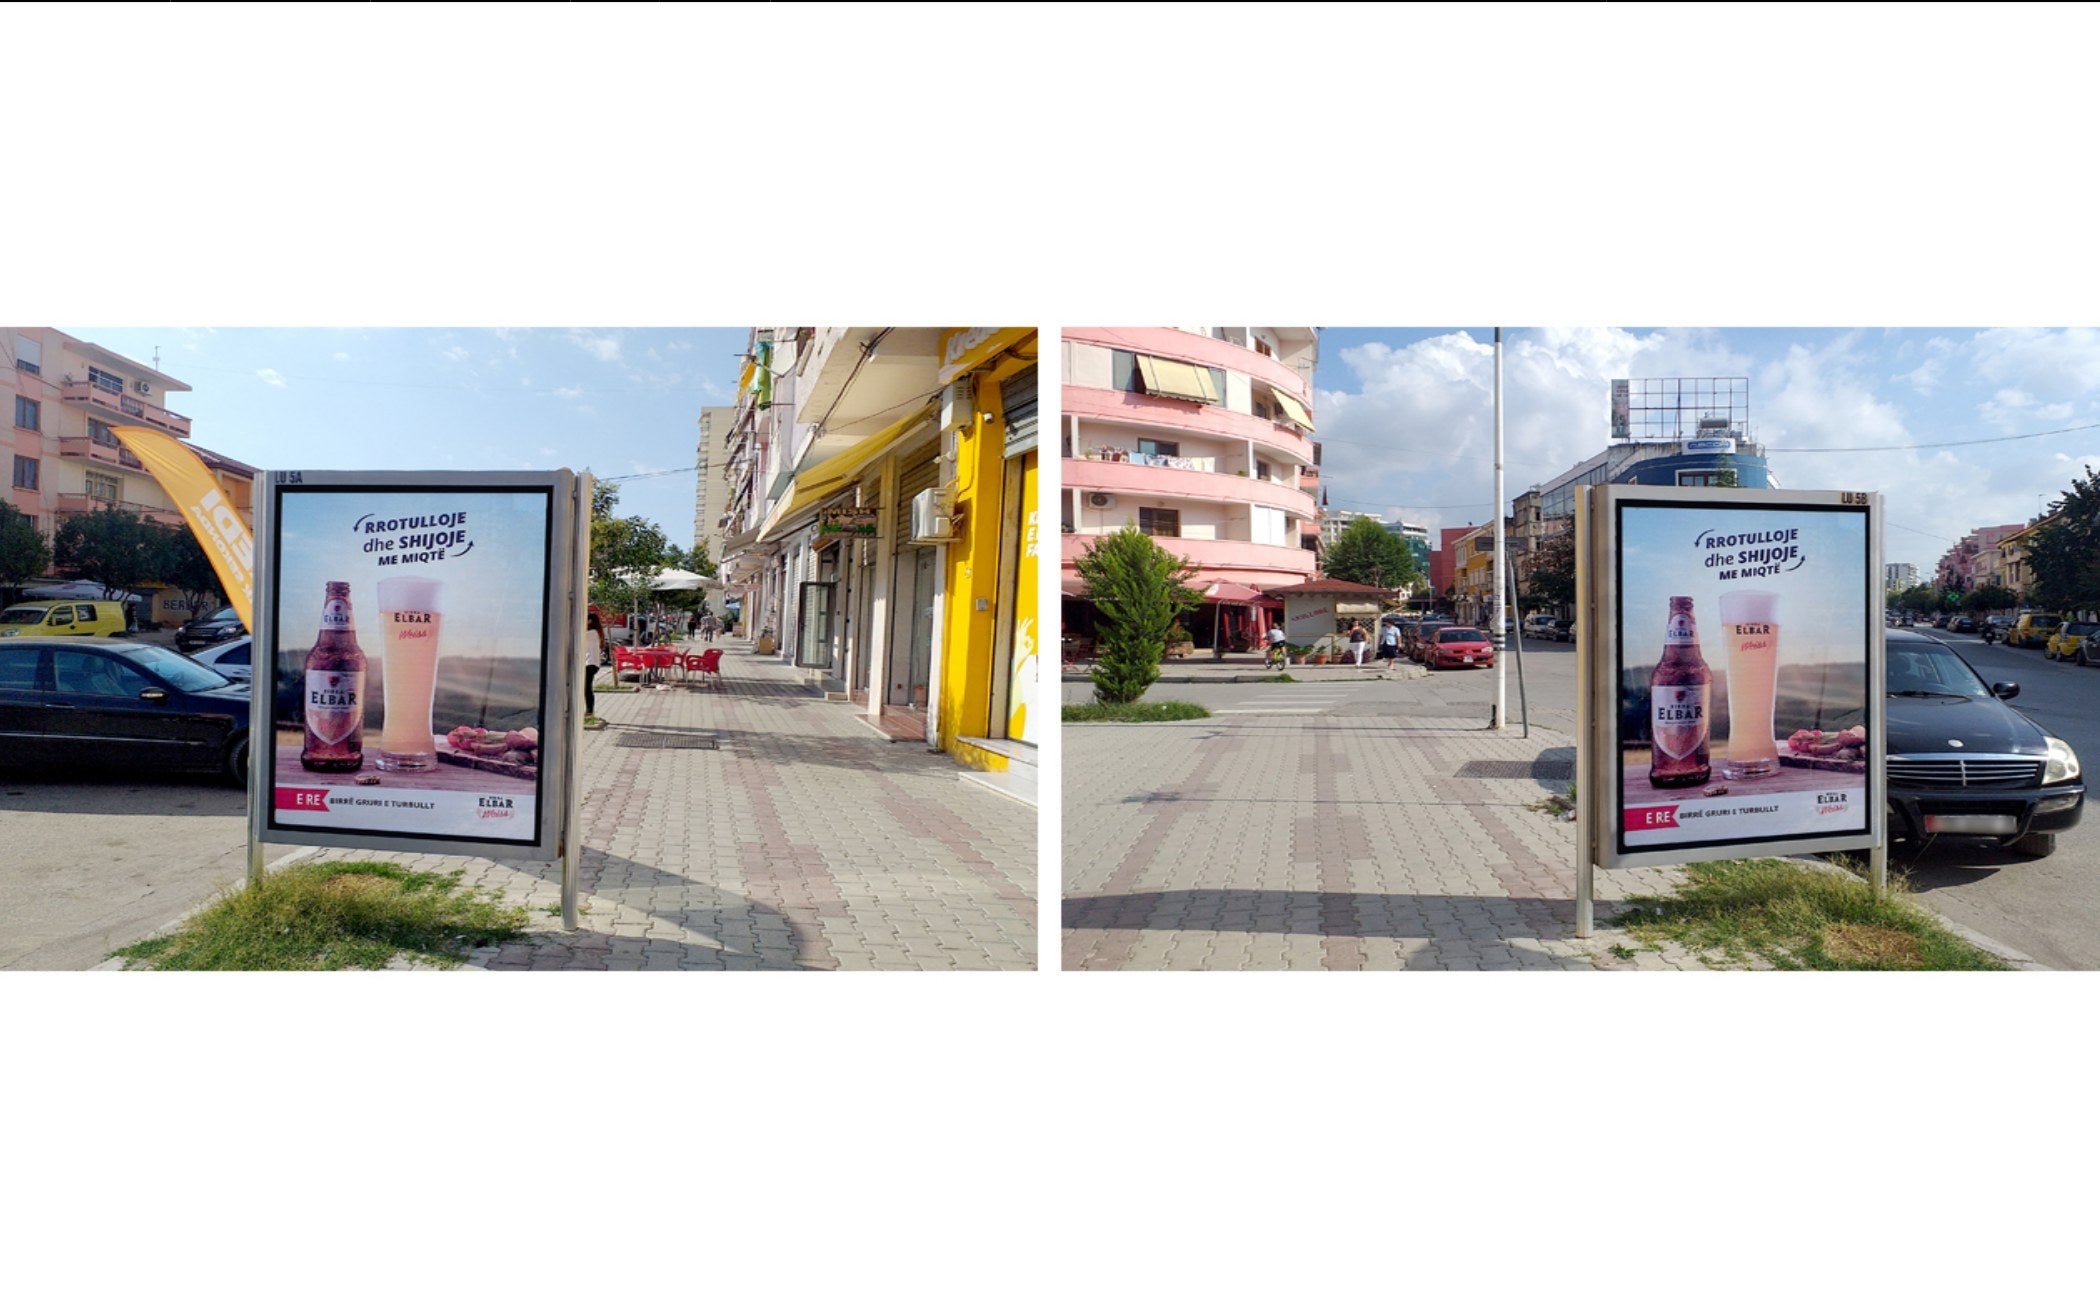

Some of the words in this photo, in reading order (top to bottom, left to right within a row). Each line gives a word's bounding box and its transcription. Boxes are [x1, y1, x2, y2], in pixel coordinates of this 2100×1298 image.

[365, 511, 467, 534] RROTULLOJE
[363, 538, 395, 553] dhe
[398, 530, 466, 550] SHIJOJE
[1705, 528, 1799, 549] RROTULLOJE
[378, 555, 398, 566] ME
[402, 547, 445, 563] MIQTË
[1704, 553, 1734, 568] dhe
[1738, 545, 1799, 564] SHIJOJE
[1719, 570, 1738, 581] ME
[1741, 563, 1780, 578] MIQTË
[394, 612, 431, 623] ELBAR
[1736, 625, 1769, 634] ELBAR
[311, 691, 357, 705] ELBAR
[1658, 705, 1703, 720] ELBAR
[296, 793, 303, 805] E
[306, 793, 320, 806] RE
[479, 797, 514, 808] ELBAR
[1646, 812, 1652, 824] E
[1656, 811, 1670, 824] RE
